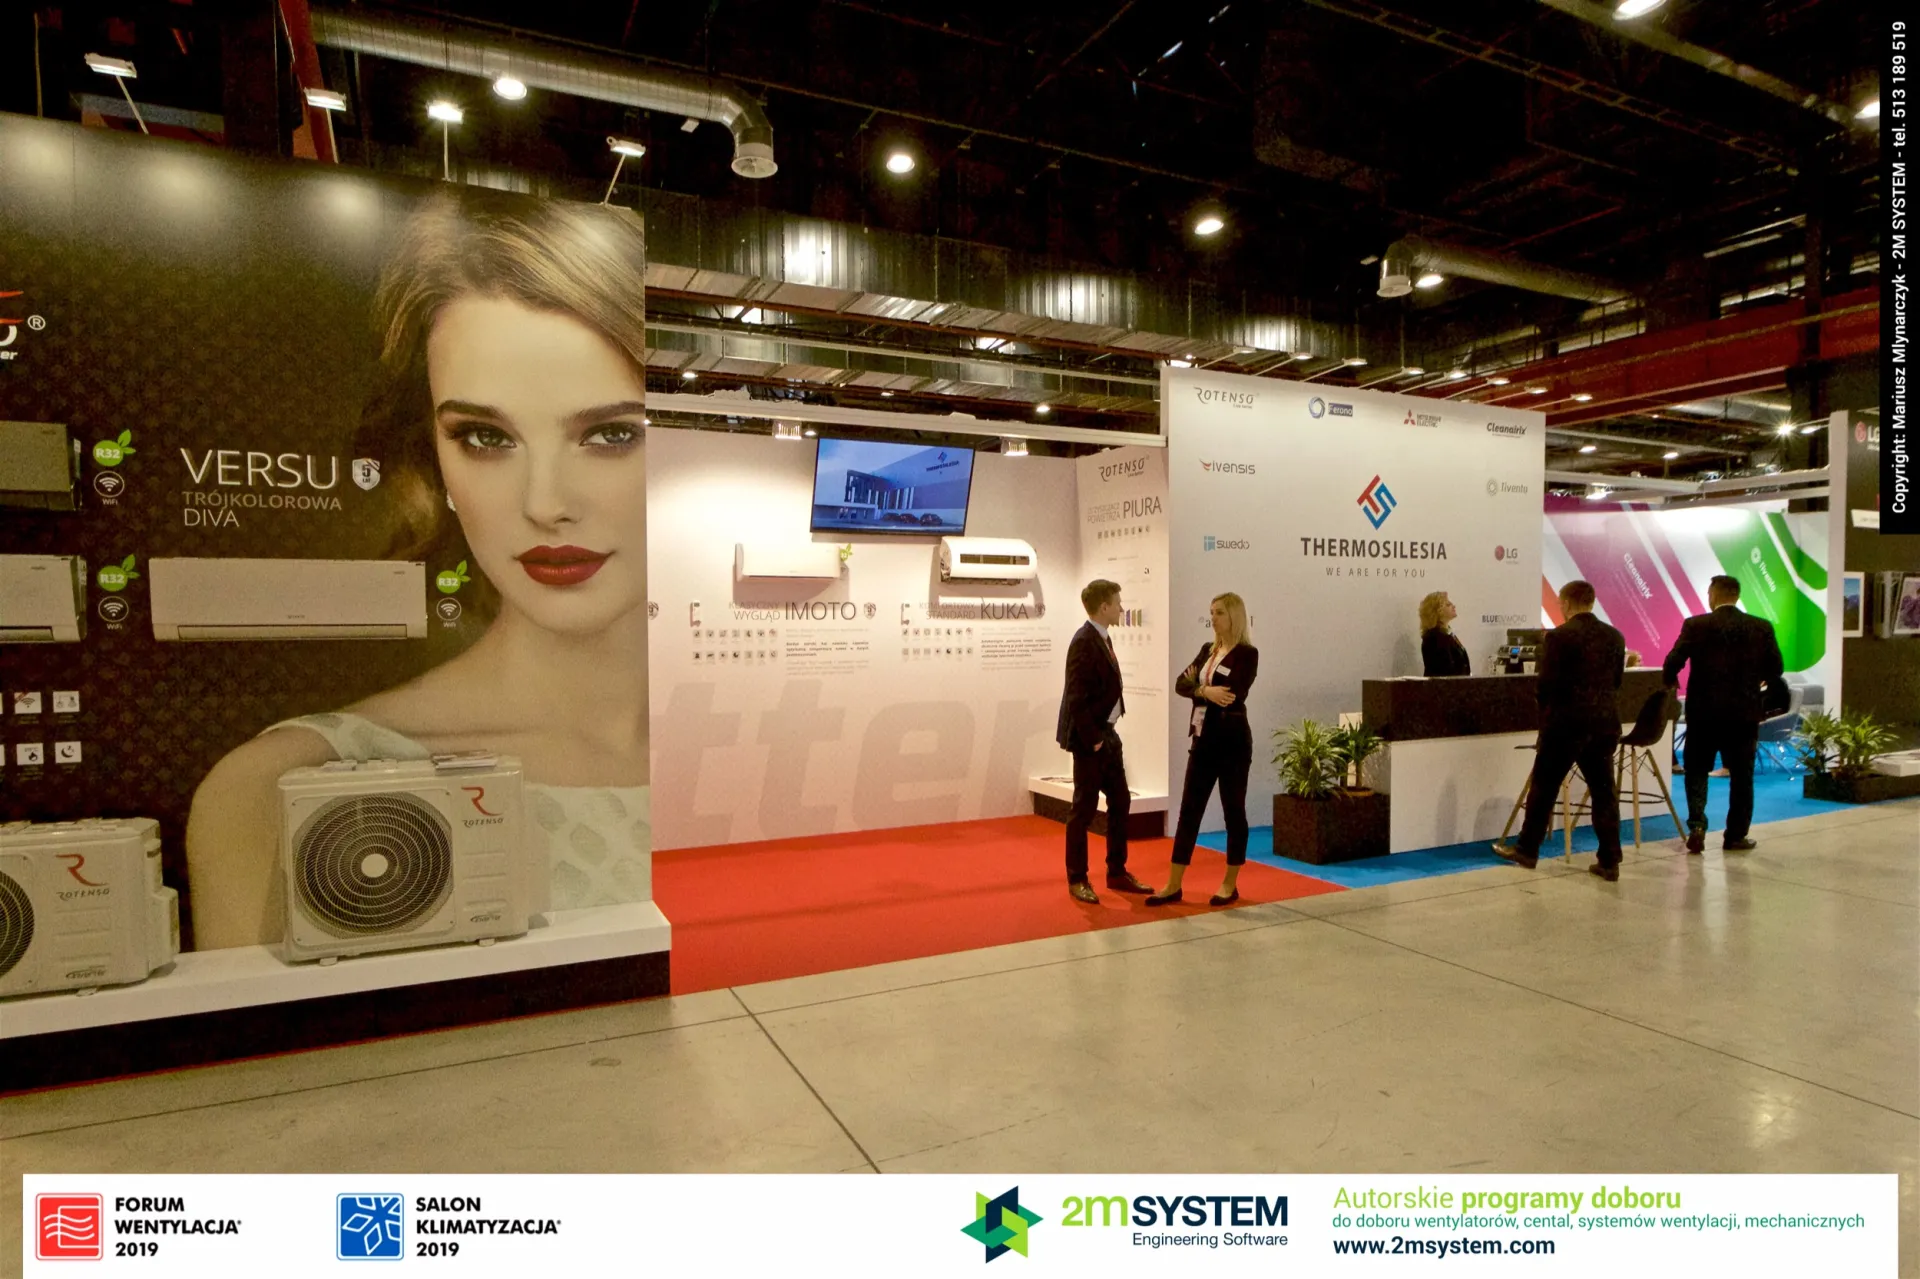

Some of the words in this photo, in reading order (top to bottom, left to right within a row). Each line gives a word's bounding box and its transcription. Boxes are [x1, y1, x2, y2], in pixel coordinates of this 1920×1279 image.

[1194, 387, 1255, 405] ROTENSO
[95, 448, 121, 460] R32
[180, 448, 338, 490] VERSU
[182, 490, 342, 511] TRÓJKOLOROWA
[1123, 496, 1162, 519] PIURA
[184, 508, 240, 528] DIVA
[1300, 537, 1448, 560] THERMOSILESIA
[1506, 548, 1518, 559] LG
[99, 573, 125, 584] R32
[1326, 567, 1341, 577] WE
[1348, 568, 1369, 577] ARE
[1376, 568, 1397, 578] FOR
[1404, 569, 1426, 578] YOU
[438, 577, 459, 587] R32
[733, 611, 781, 622] WYGLĄD
[785, 601, 857, 621] IMOTO
[926, 610, 976, 620] STANDARD
[980, 603, 1029, 620] KUKA
